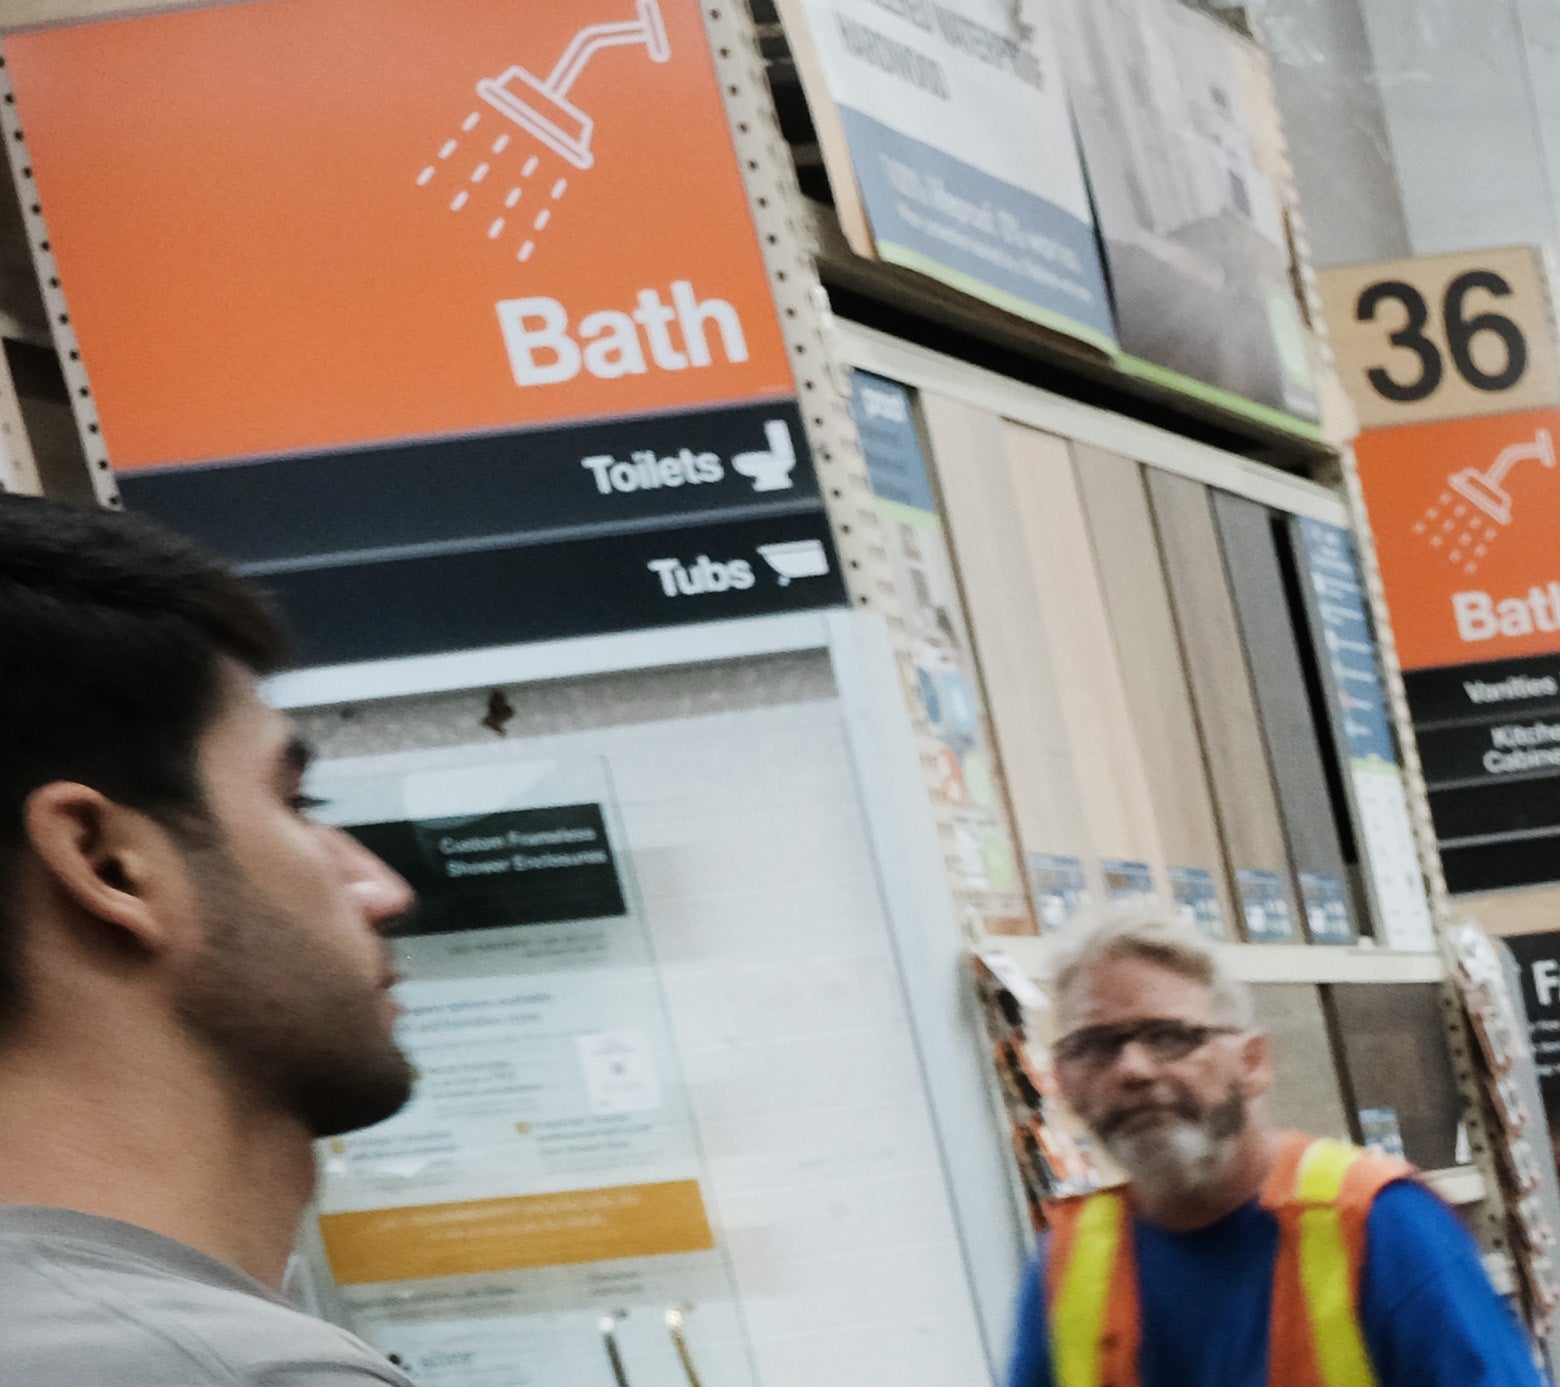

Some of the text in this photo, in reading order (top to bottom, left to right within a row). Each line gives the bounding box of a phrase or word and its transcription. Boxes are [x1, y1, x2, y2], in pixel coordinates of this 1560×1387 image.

[498, 280, 748, 388] Bath
[1355, 269, 1528, 404] 36
[583, 446, 723, 494] Toilets
[648, 558, 755, 598] Tubs
[1463, 671, 1557, 705] Vanities
